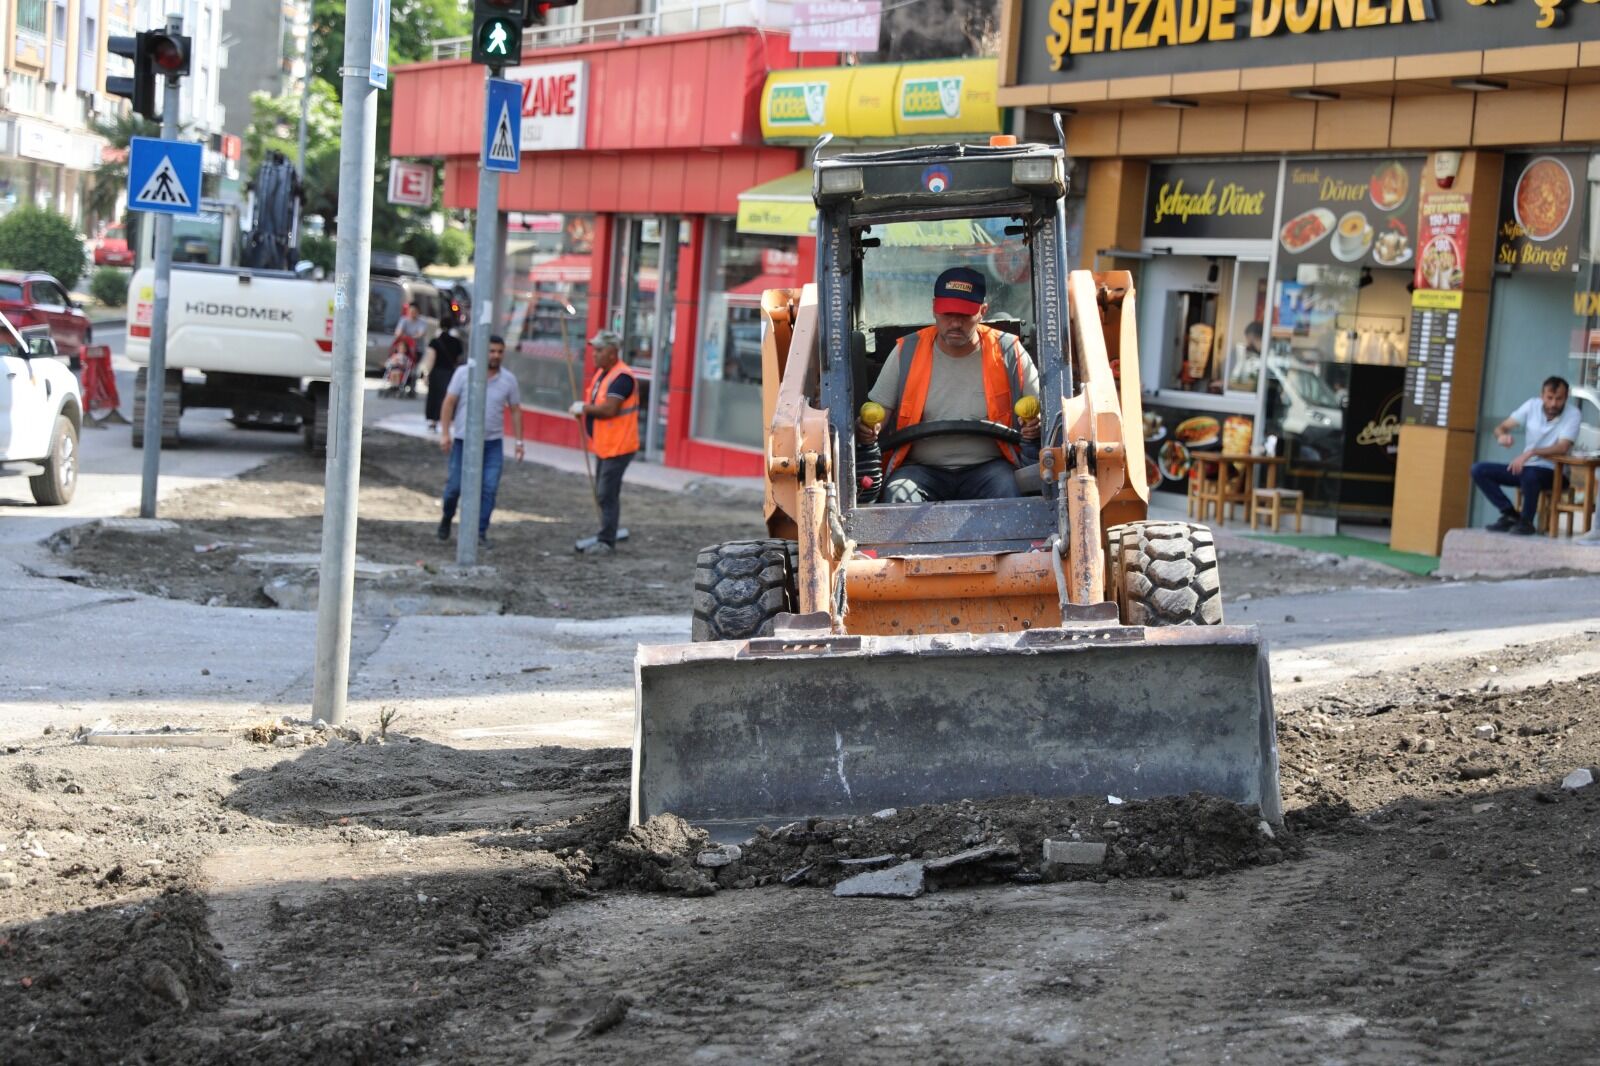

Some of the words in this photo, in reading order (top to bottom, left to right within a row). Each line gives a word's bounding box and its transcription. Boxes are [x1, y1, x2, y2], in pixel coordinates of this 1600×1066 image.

[1045, 0, 1237, 72] ŞEHZADE
[522, 74, 576, 117] ZANE
[905, 86, 942, 112] iddaa
[402, 171, 423, 196] E
[1319, 176, 1369, 201] Döner
[1154, 178, 1216, 224] Şehzade
[1216, 182, 1266, 217] Döner
[1499, 243, 1517, 264] Su
[1521, 241, 1568, 272] Böreği
